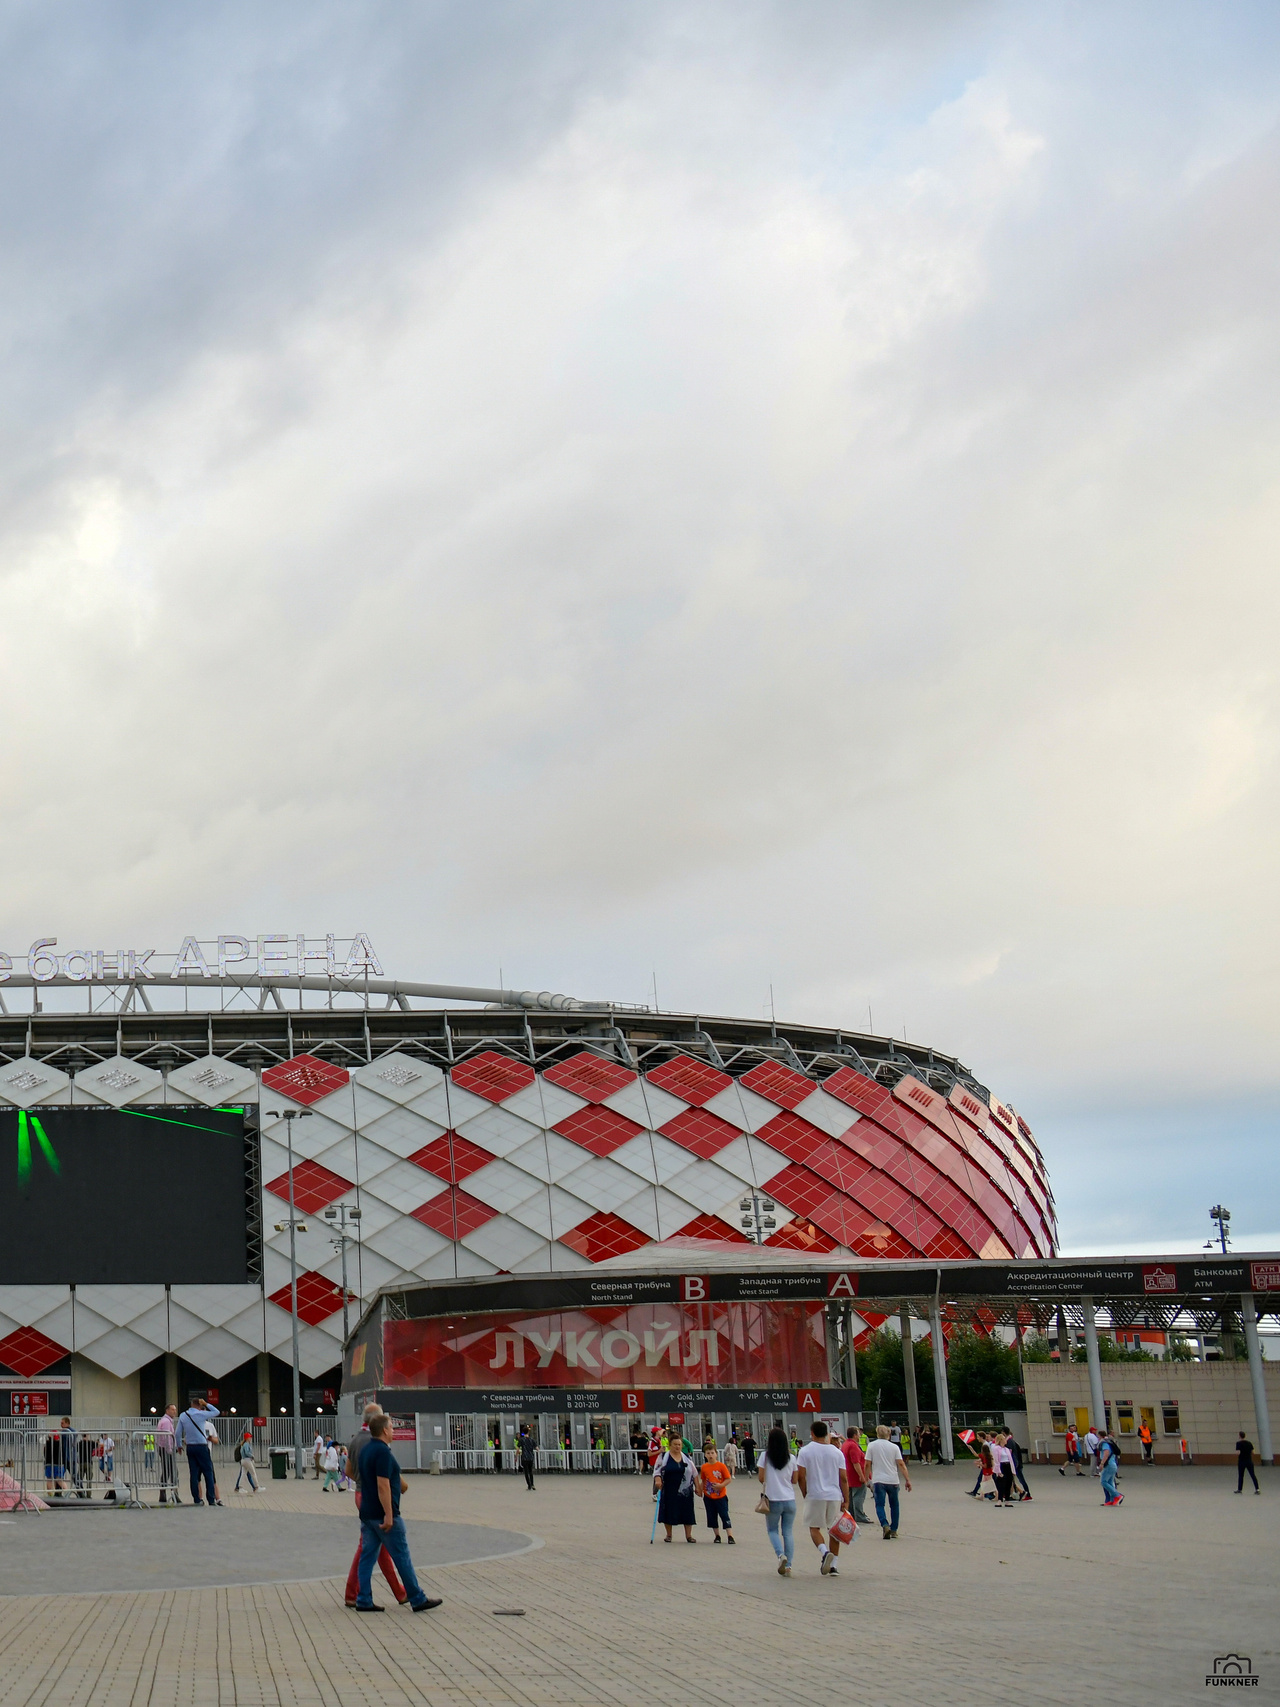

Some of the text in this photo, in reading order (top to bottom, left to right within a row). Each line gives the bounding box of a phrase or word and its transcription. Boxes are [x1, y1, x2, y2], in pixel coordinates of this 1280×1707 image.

[28, 937, 156, 982] банк
[170, 932, 384, 979] АРЕНА
[1007, 1270, 1134, 1281] Аккредитационный центр
[1193, 1268, 1244, 1277] Банкомат
[591, 1280, 671, 1291] Северная трибуна
[739, 1276, 821, 1287] Западная трибуна
[829, 1273, 855, 1296] A
[1007, 1283, 1056, 1291] Accreditation
[684, 1276, 706, 1300] B
[759, 1287, 779, 1295] Stand
[613, 1293, 633, 1301] Stand
[489, 1321, 720, 1369] ЛУКОЙЛ
[490, 1394, 555, 1402] Северная трибуна
[627, 1393, 639, 1409] B
[677, 1393, 695, 1402] Gold,
[802, 1393, 816, 1408] A
